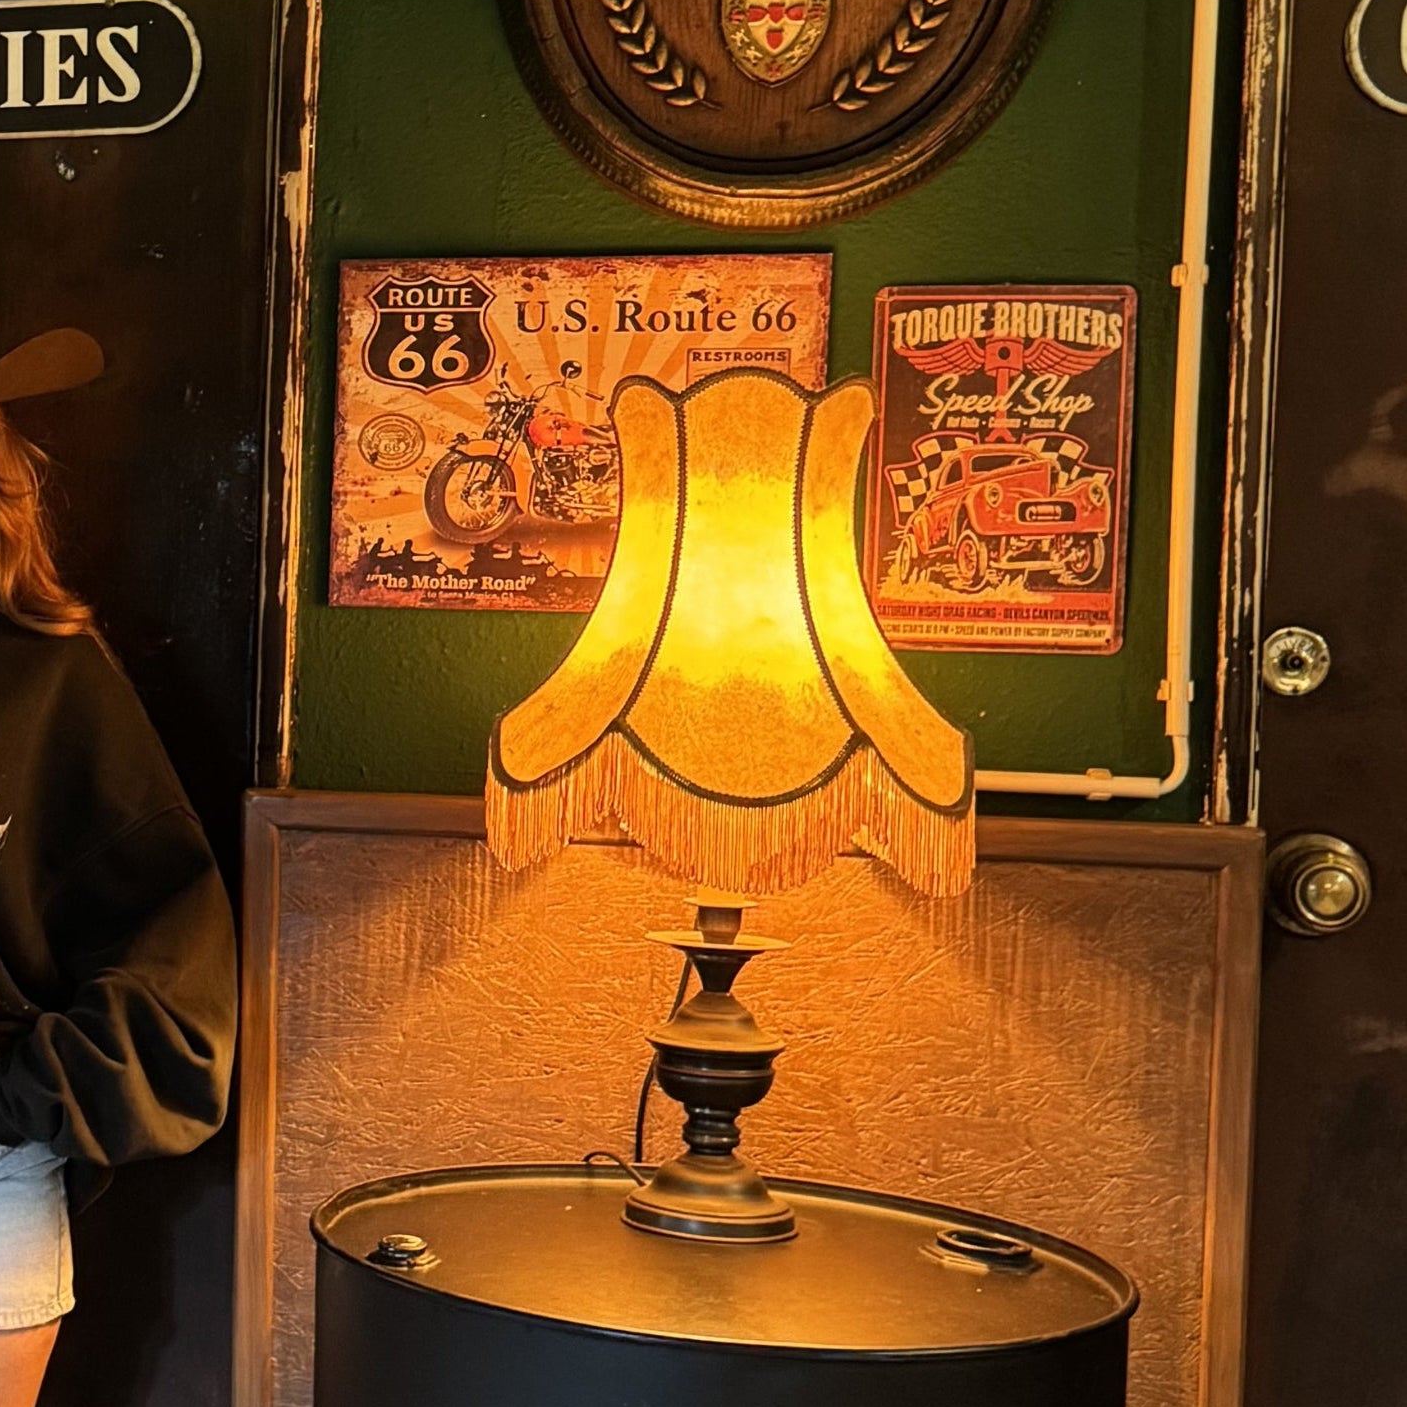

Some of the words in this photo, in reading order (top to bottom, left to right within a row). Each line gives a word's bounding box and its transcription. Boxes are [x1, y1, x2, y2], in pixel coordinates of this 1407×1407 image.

[388, 287, 472, 307] ROUTE
[515, 299, 599, 334] U.S.
[613, 300, 736, 334] Route
[751, 299, 798, 332] 66
[893, 304, 988, 349] TORQUE
[992, 301, 1123, 349] BROTHERS
[388, 334, 470, 380] 66
[691, 350, 788, 364] RESTROOMS
[918, 373, 1024, 430] Speed
[1015, 373, 1095, 431] Shop
[412, 574, 478, 590] Mother
